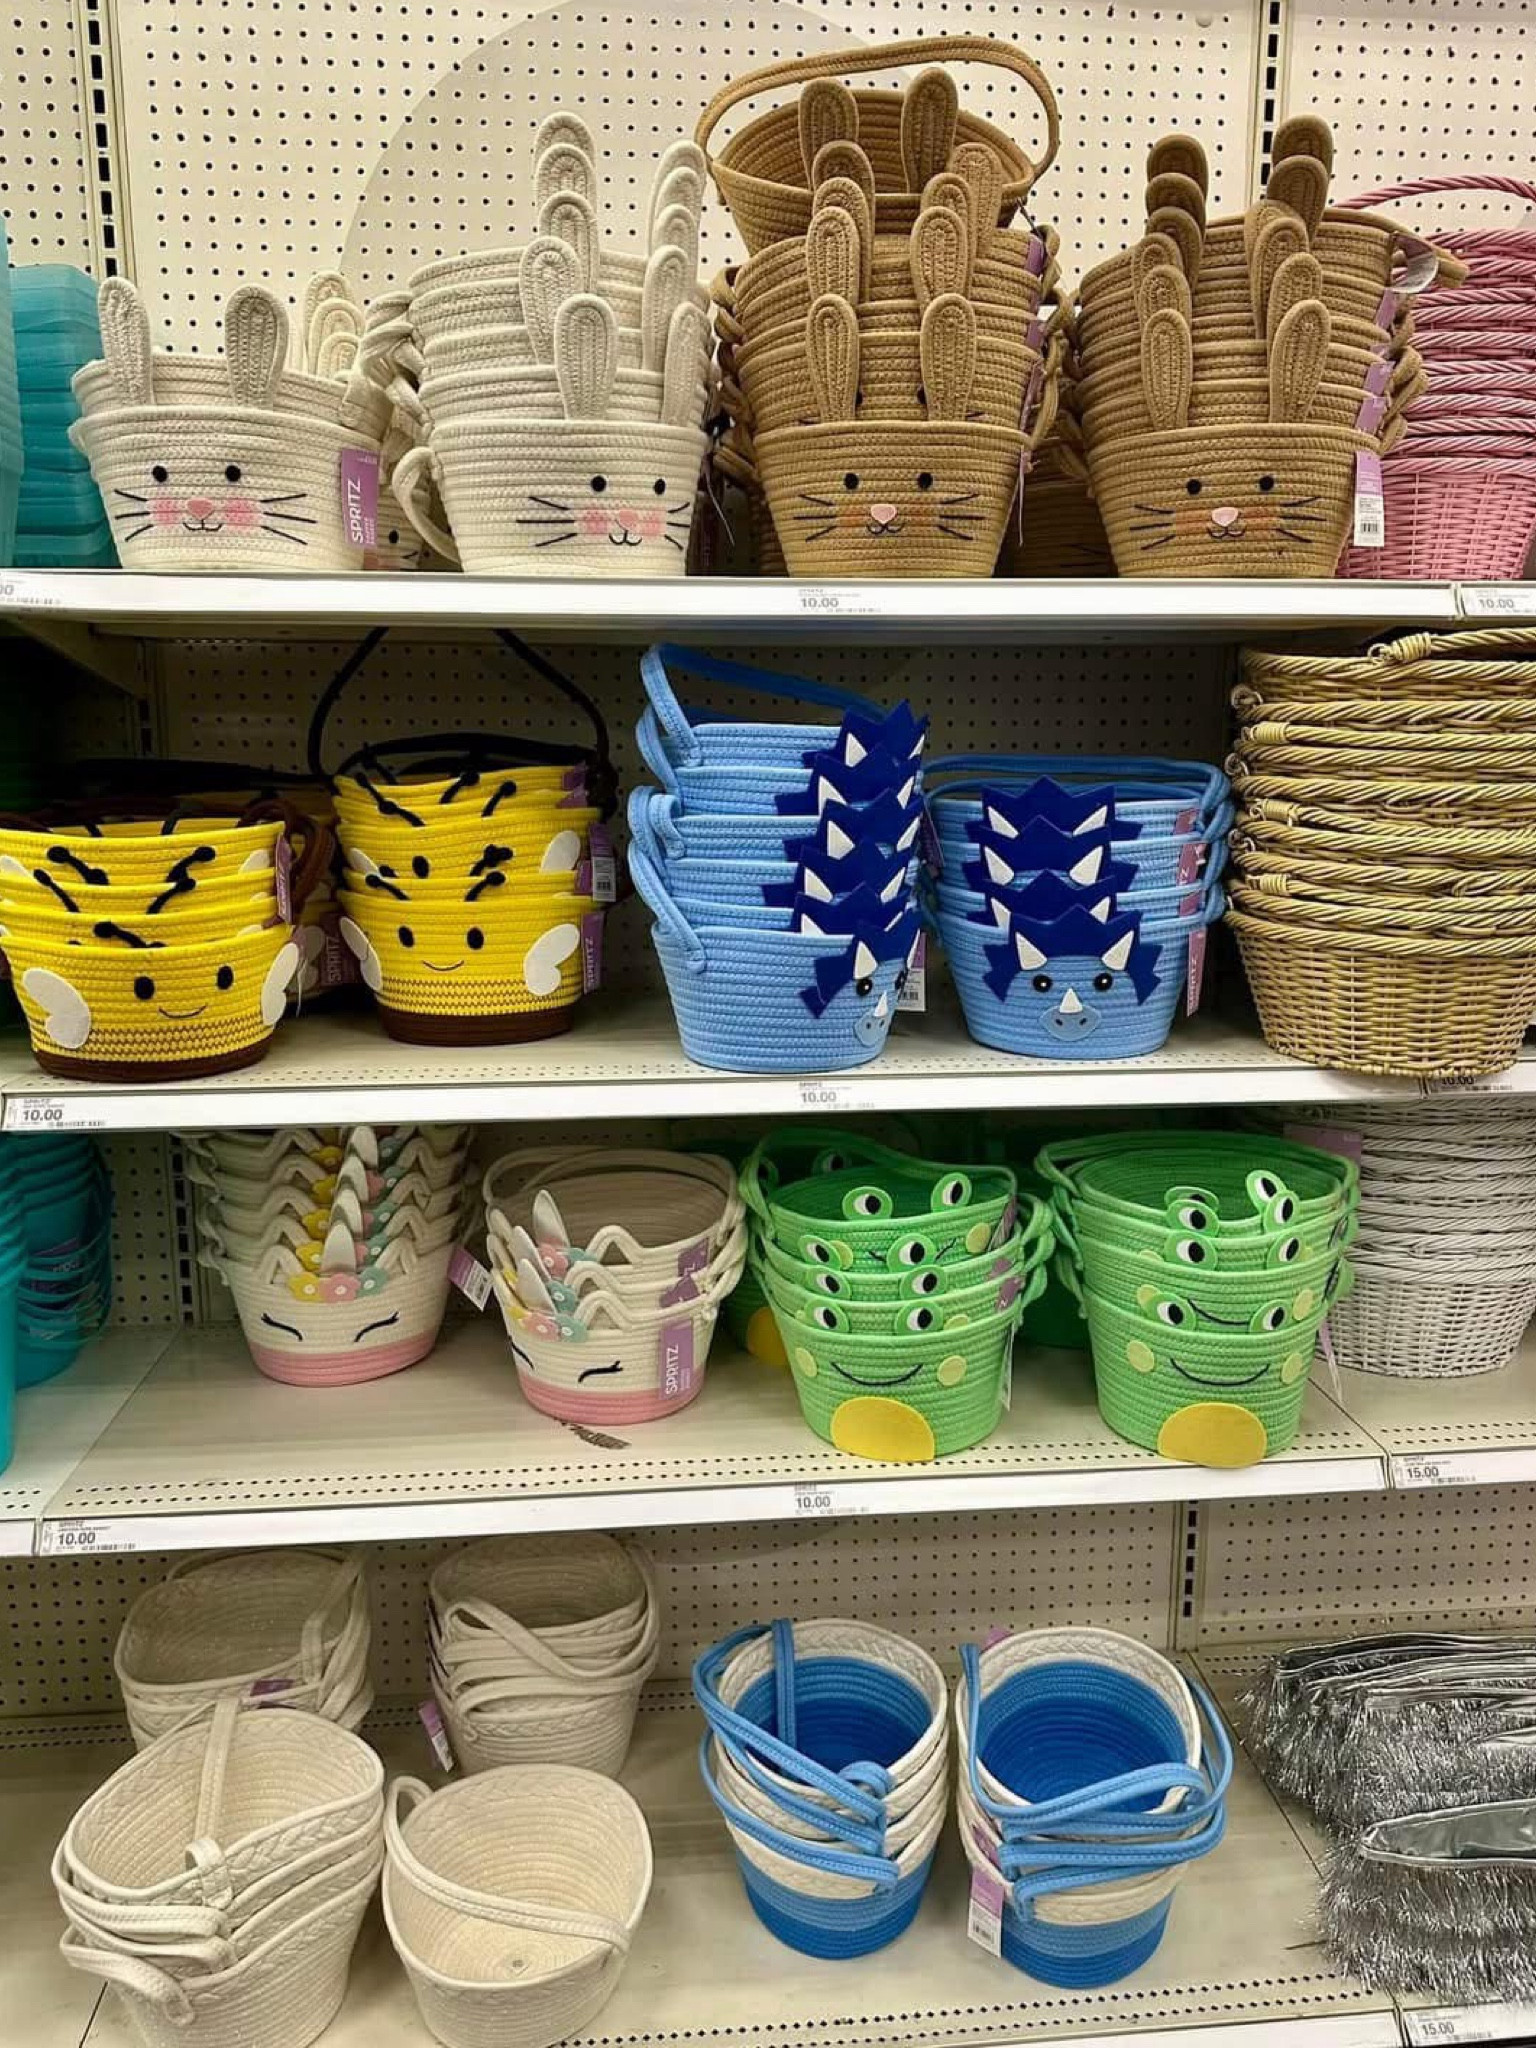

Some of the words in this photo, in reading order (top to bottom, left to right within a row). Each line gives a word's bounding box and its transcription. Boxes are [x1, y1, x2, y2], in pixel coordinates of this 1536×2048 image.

[347, 478, 363, 543] SPRITZ
[800, 597, 839, 608] 10.00
[1479, 598, 1514, 609] 10.00
[326, 936, 342, 982] SPRITZ
[801, 1091, 837, 1103] 10.00
[23, 1108, 63, 1121] 10.00
[666, 1344, 679, 1395] SPRITZ
[1406, 1466, 1439, 1479] 15.00
[795, 1496, 831, 1509] 10.00
[59, 1532, 96, 1545] 10.00
[1422, 2021, 1455, 2036] 15.00
